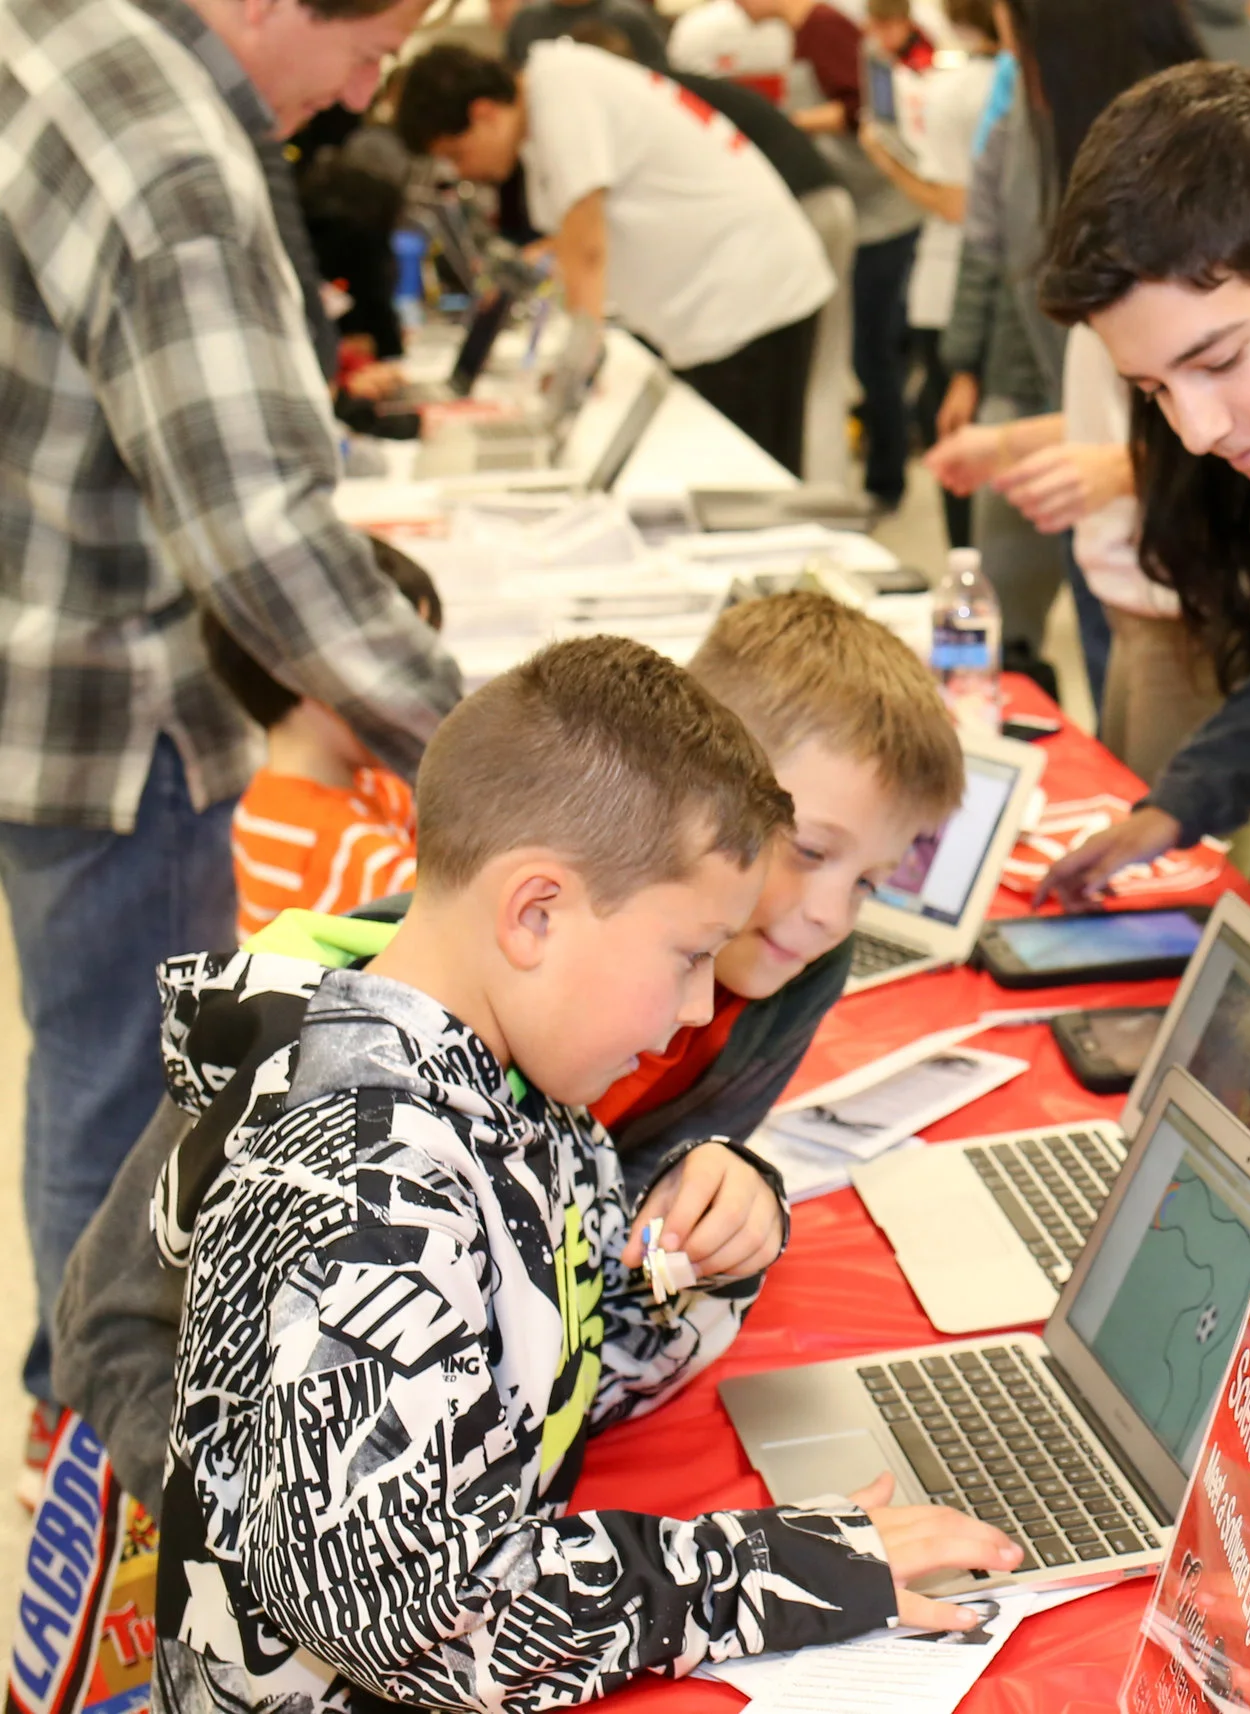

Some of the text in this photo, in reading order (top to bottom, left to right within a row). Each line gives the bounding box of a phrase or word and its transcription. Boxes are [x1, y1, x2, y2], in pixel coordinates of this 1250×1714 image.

[1201, 1441, 1229, 1515] Meet
[1215, 1493, 1228, 1528] a
[1219, 1494, 1250, 1598] Software
